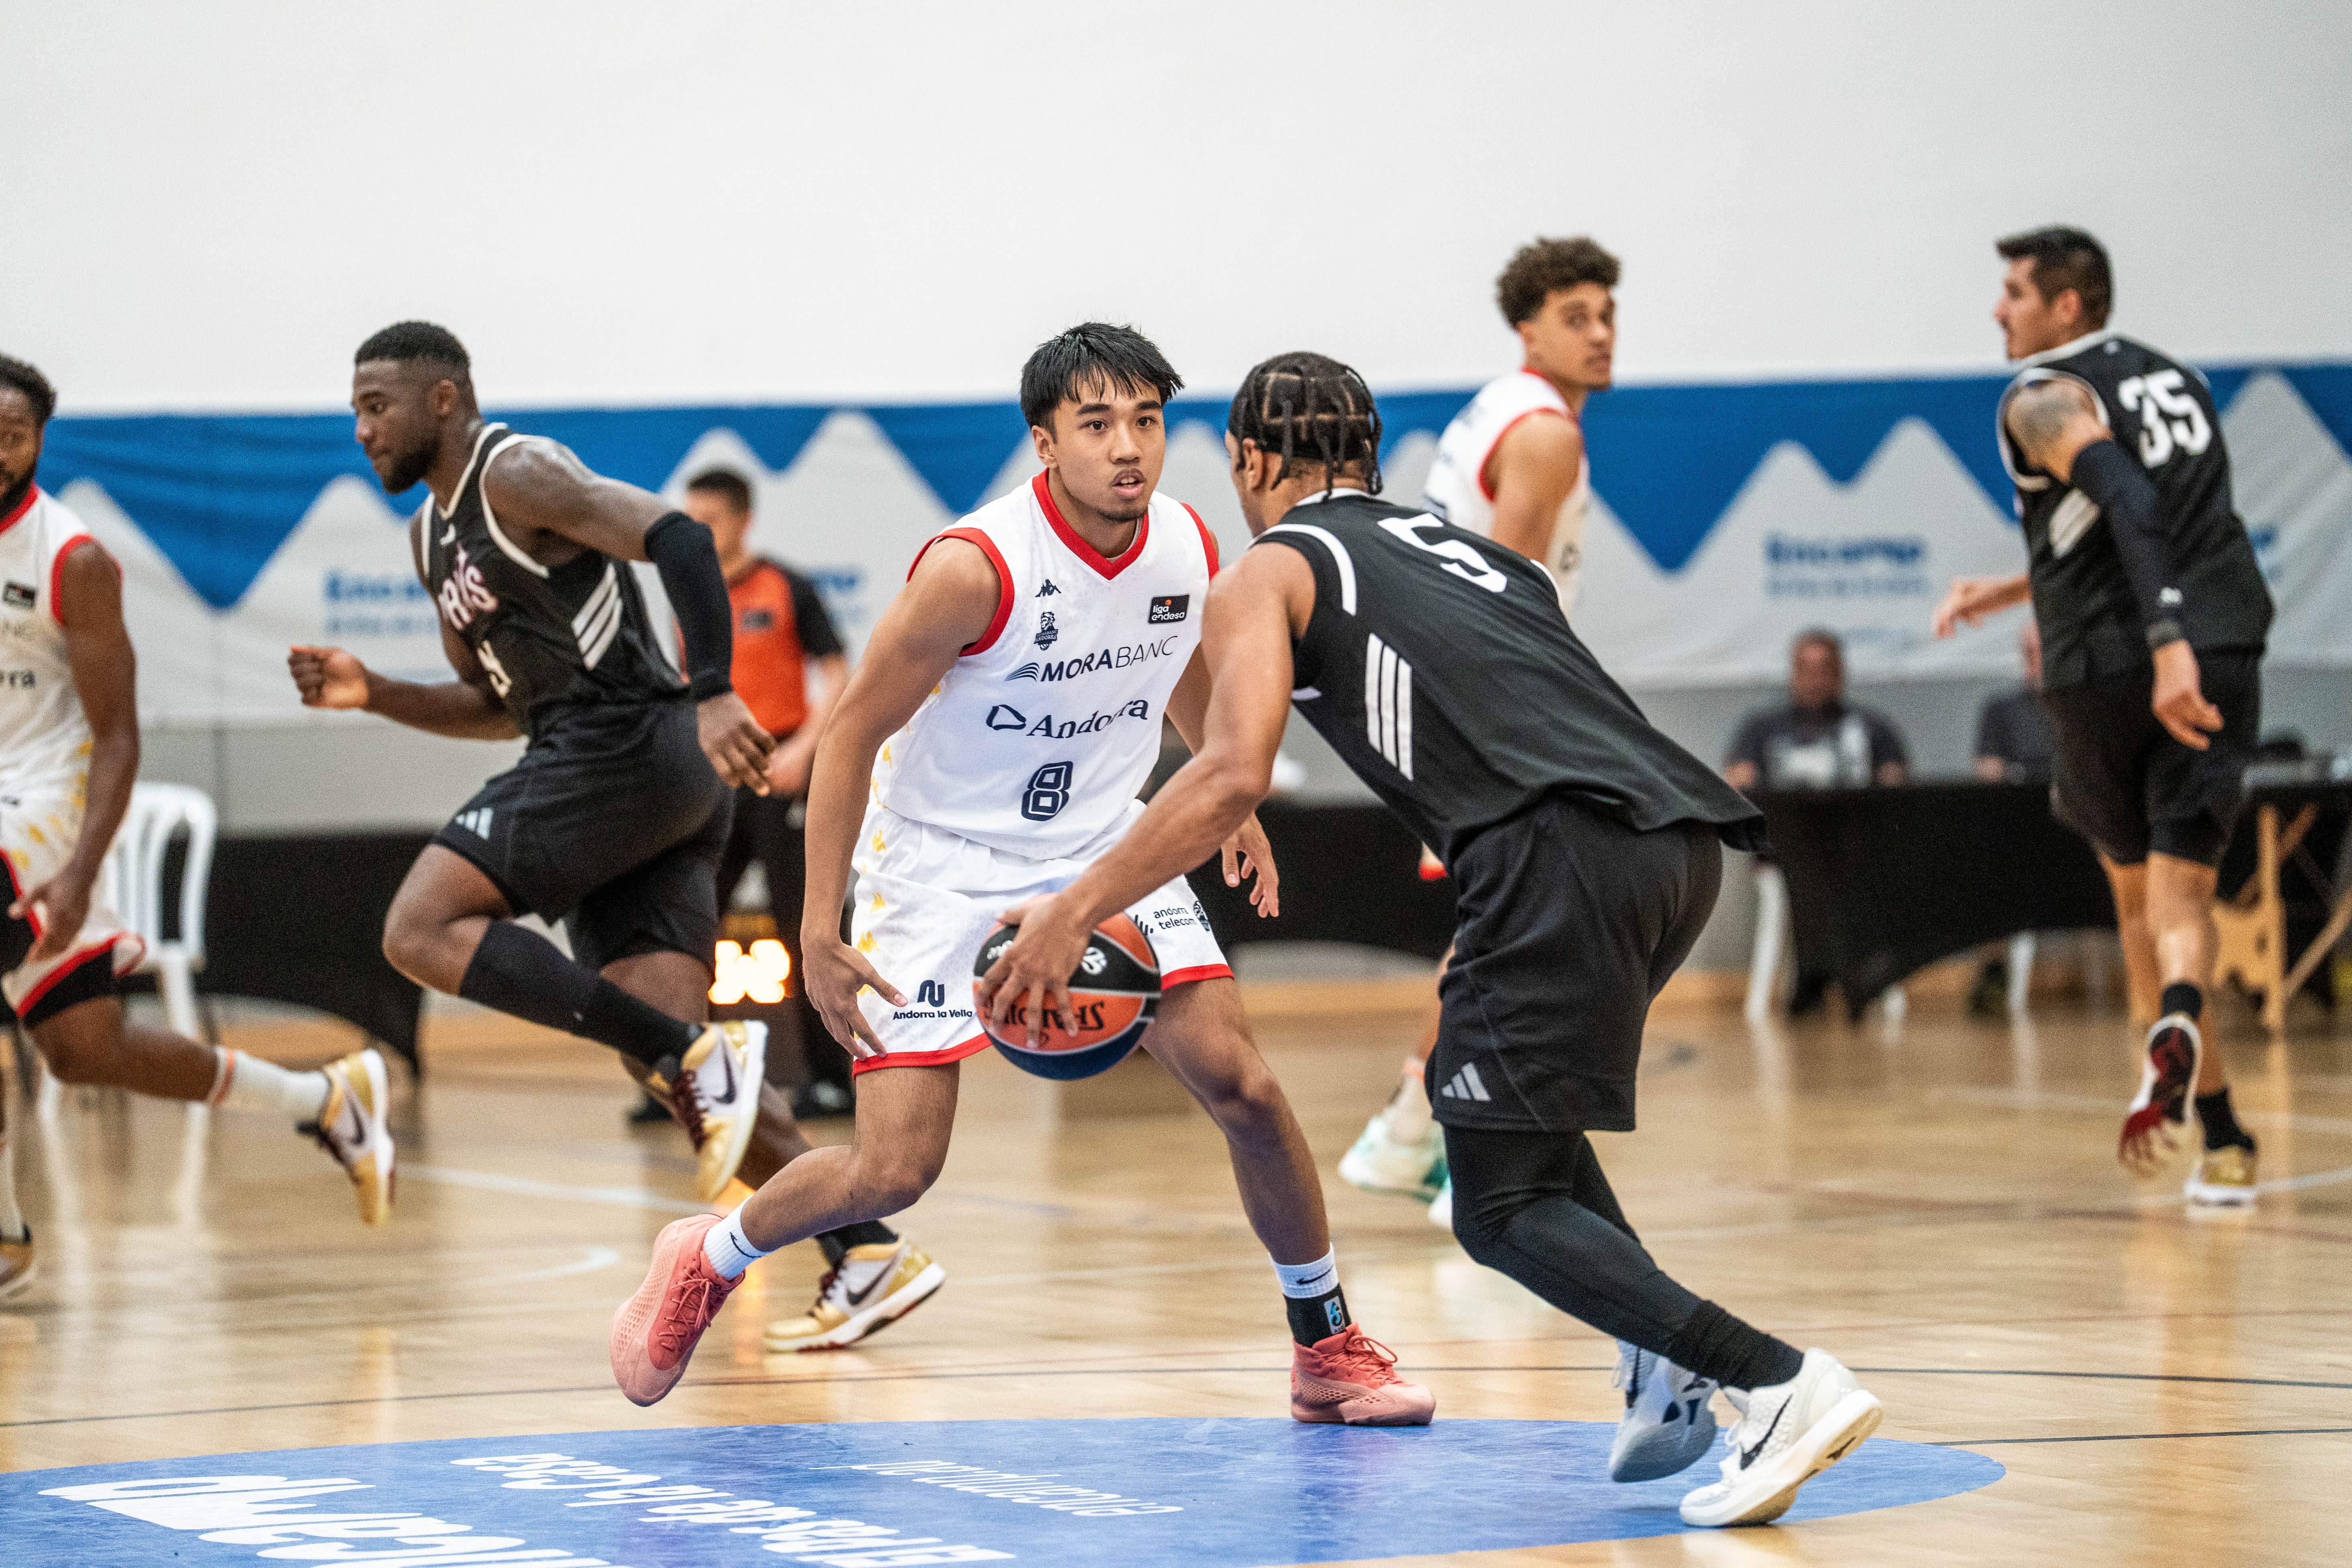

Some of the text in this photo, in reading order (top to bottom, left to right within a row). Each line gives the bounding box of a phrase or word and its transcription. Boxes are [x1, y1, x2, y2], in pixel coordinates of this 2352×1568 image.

[2118, 368, 2212, 469] 35
[1378, 512, 1507, 593] 5
[438, 542, 499, 631] RIS
[1151, 612, 1185, 620] endesa
[1152, 605, 1169, 614] liga
[1040, 636, 1178, 682] MORABANC
[1026, 699, 1148, 739] Andorra
[1021, 761, 1073, 821] 8
[1159, 918, 1197, 929] telecom
[893, 1011, 935, 1020] Andorra
[949, 1009, 972, 1017] Vella
[449, 1453, 663, 1489] Casa
[809, 1460, 1185, 1517] encamp.ad
[563, 1485, 735, 1507] la
[636, 1499, 819, 1523] de
[37, 1475, 633, 1568] ncamp
